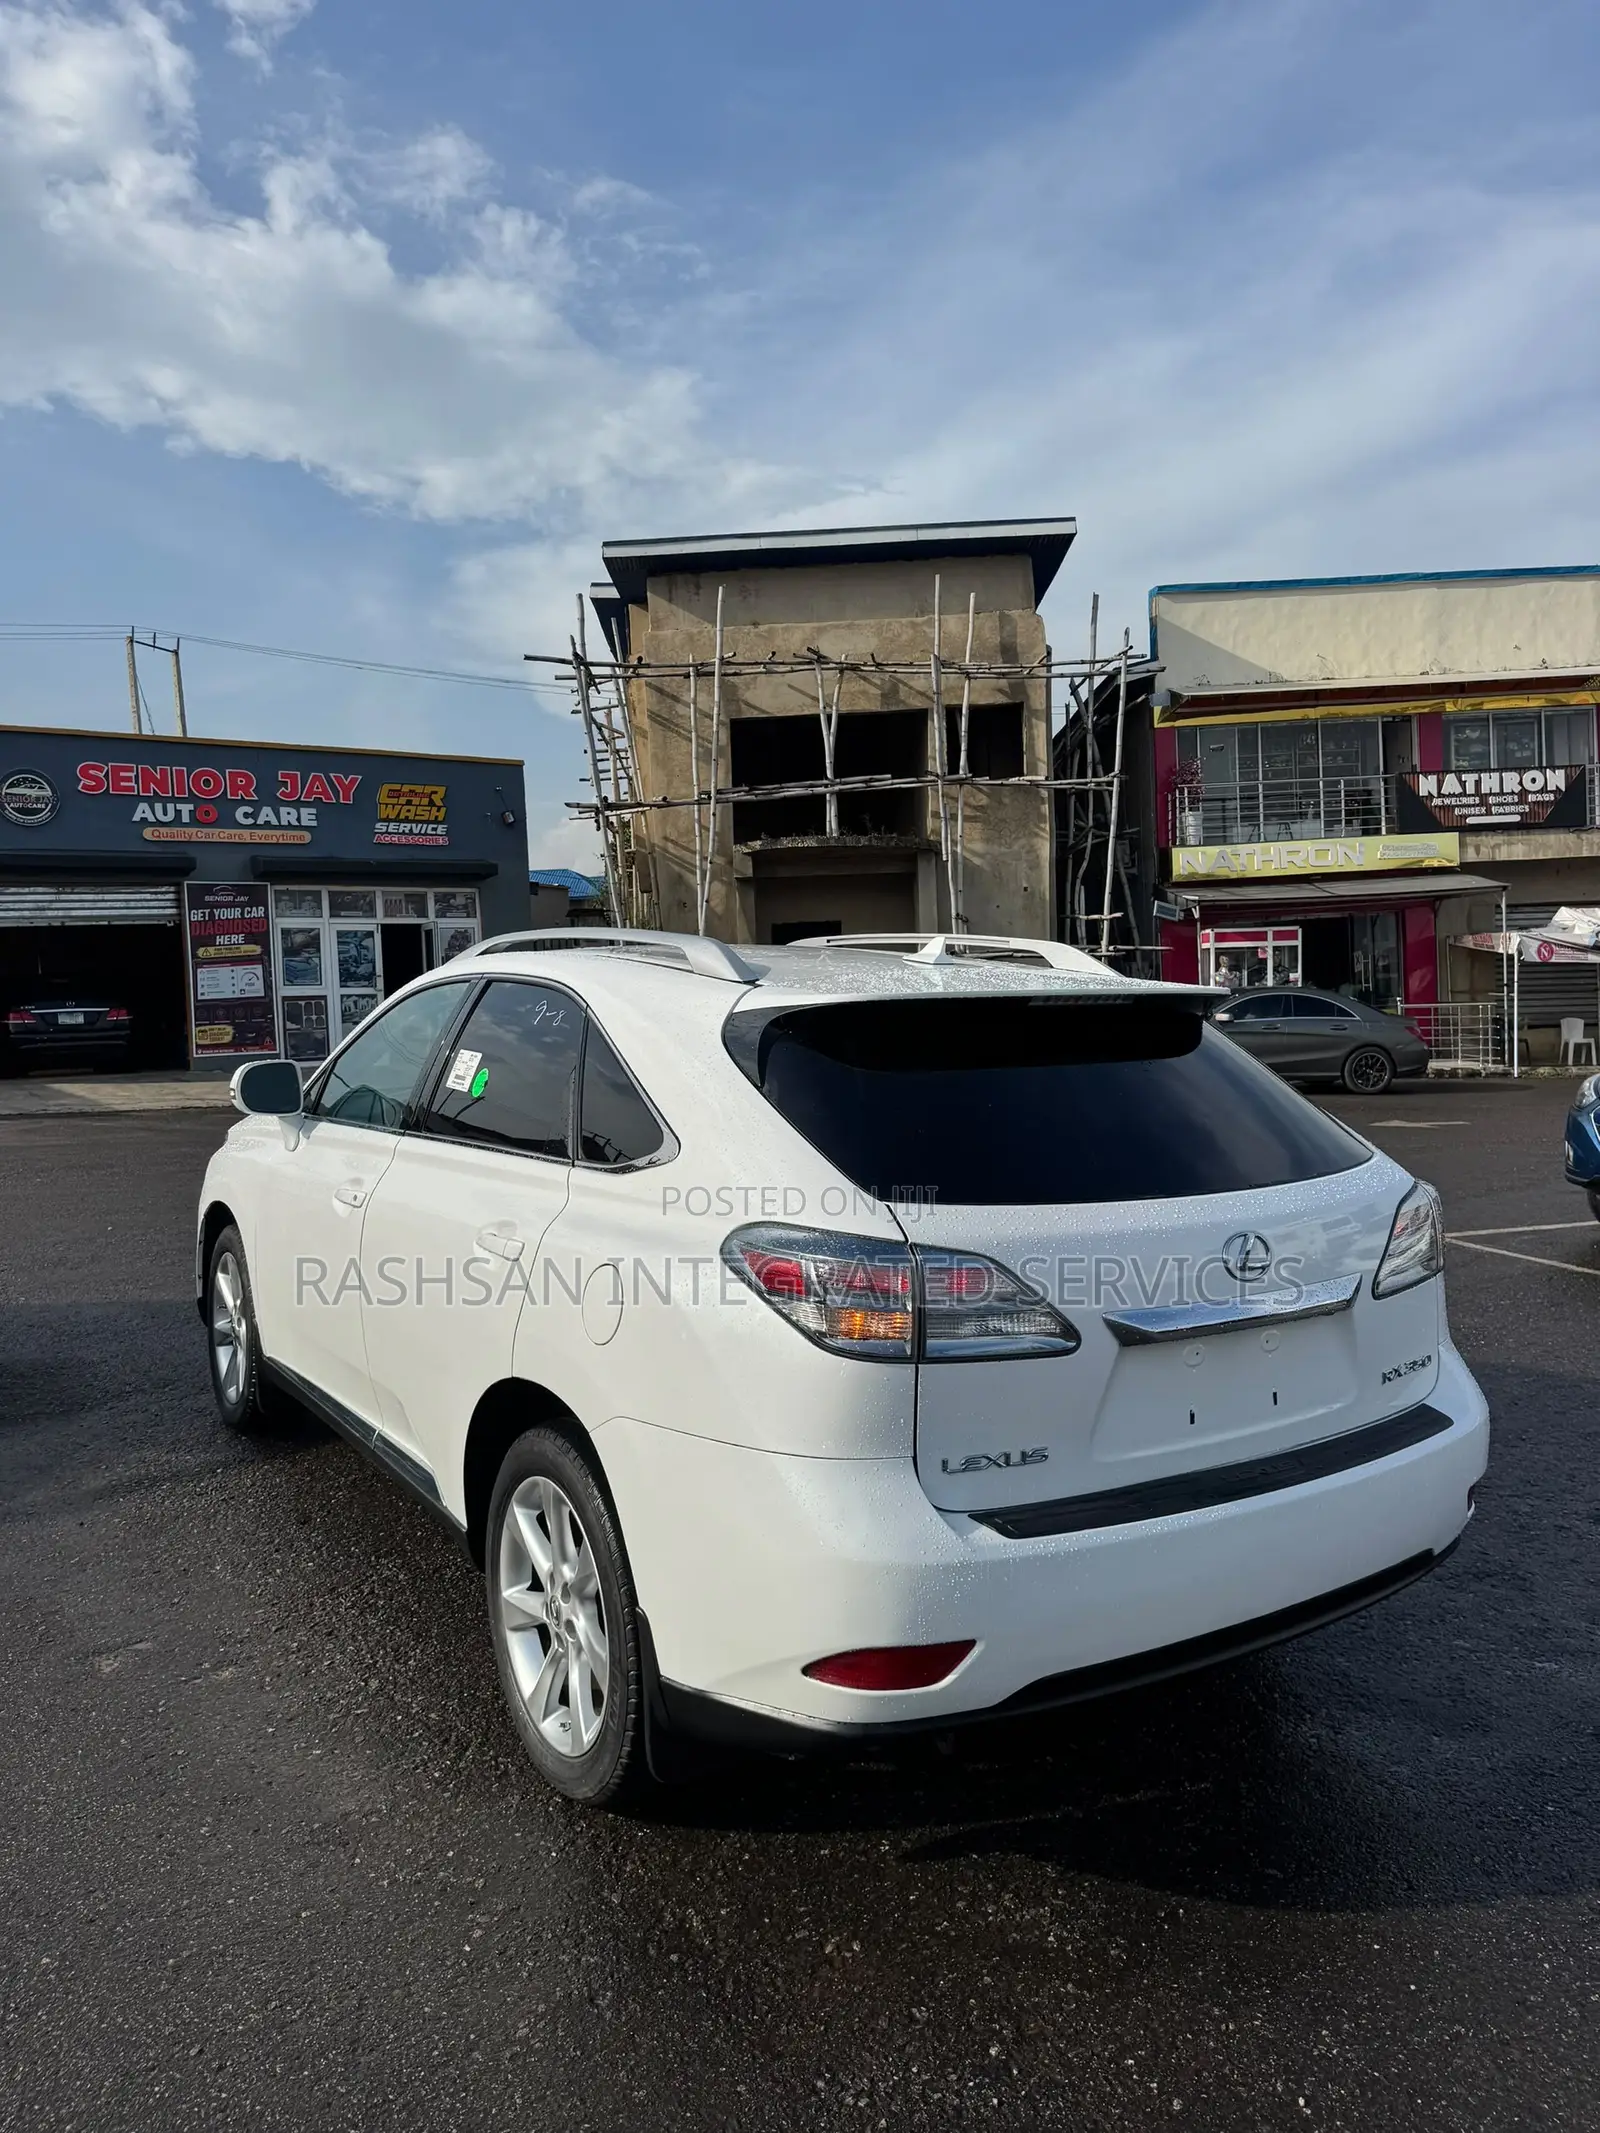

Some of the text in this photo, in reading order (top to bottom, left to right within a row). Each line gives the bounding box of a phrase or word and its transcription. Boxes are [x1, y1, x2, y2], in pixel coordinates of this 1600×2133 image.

[76, 761, 363, 804] SENIOR JAY
[1418, 769, 1567, 797] NATHRON
[378, 783, 447, 806] CAR
[1432, 793, 1555, 806] JEWELRIES SHOES BAGS
[131, 802, 318, 827] AUTO CARE
[379, 804, 447, 821] WASH
[1454, 804, 1530, 816] UNISEX FABRICS
[151, 828, 306, 843] Quality Car Care, Everytime
[374, 822, 449, 835] SERVICE
[373, 834, 450, 846] ACCESSORIES
[1179, 842, 1365, 876] NATHRON
[190, 906, 265, 922] GET YOUR CAR
[190, 918, 268, 936] DIAGNOSED
[215, 934, 246, 945] HERE
[941, 1447, 1049, 1475] LEXUS
